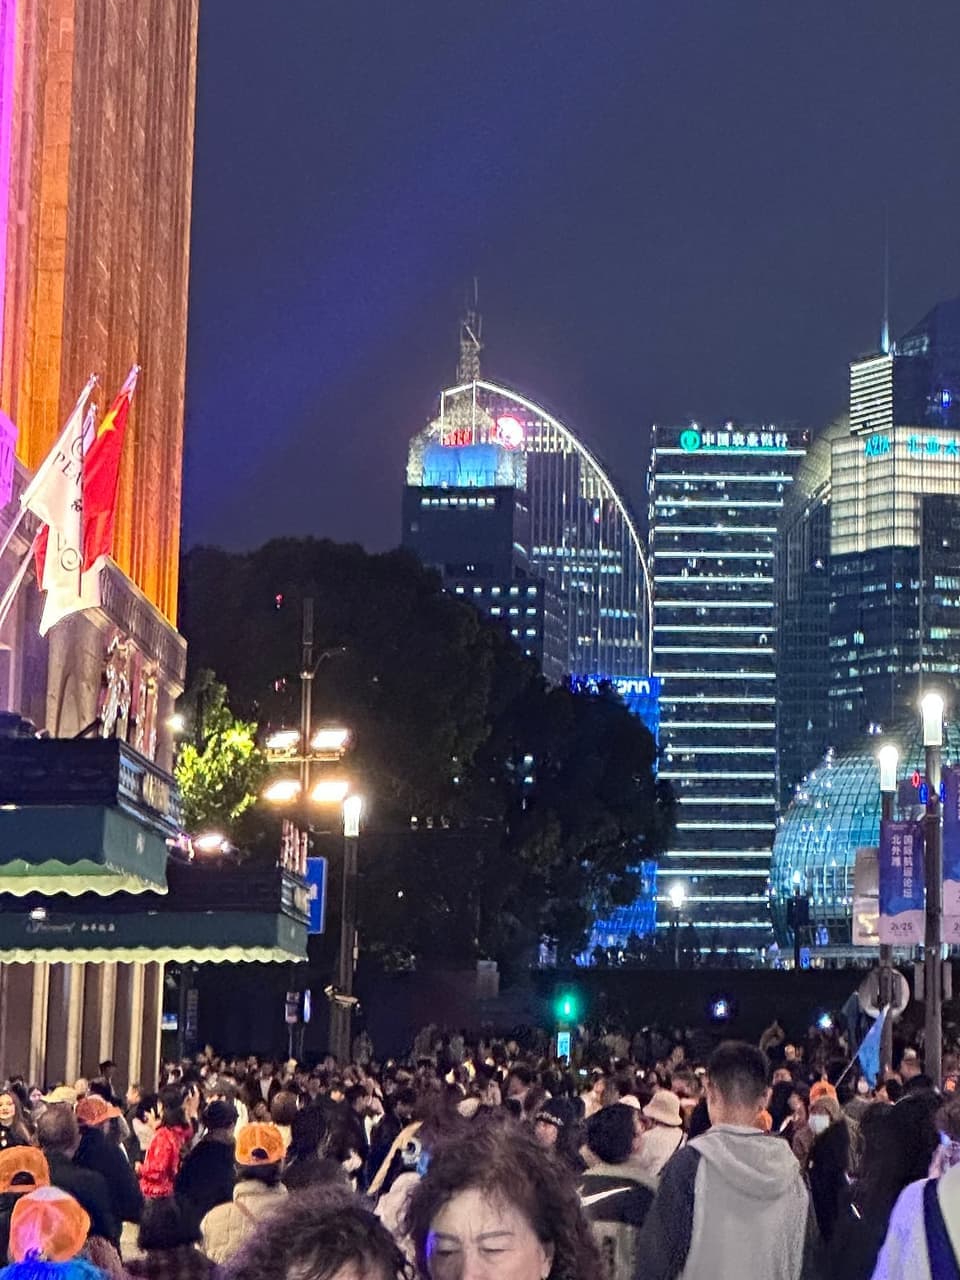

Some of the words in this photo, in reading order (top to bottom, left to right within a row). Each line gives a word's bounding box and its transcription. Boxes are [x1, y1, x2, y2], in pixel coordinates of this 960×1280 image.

[701, 430, 788, 448] 中国农业银行
[864, 433, 890, 457] AZIA
